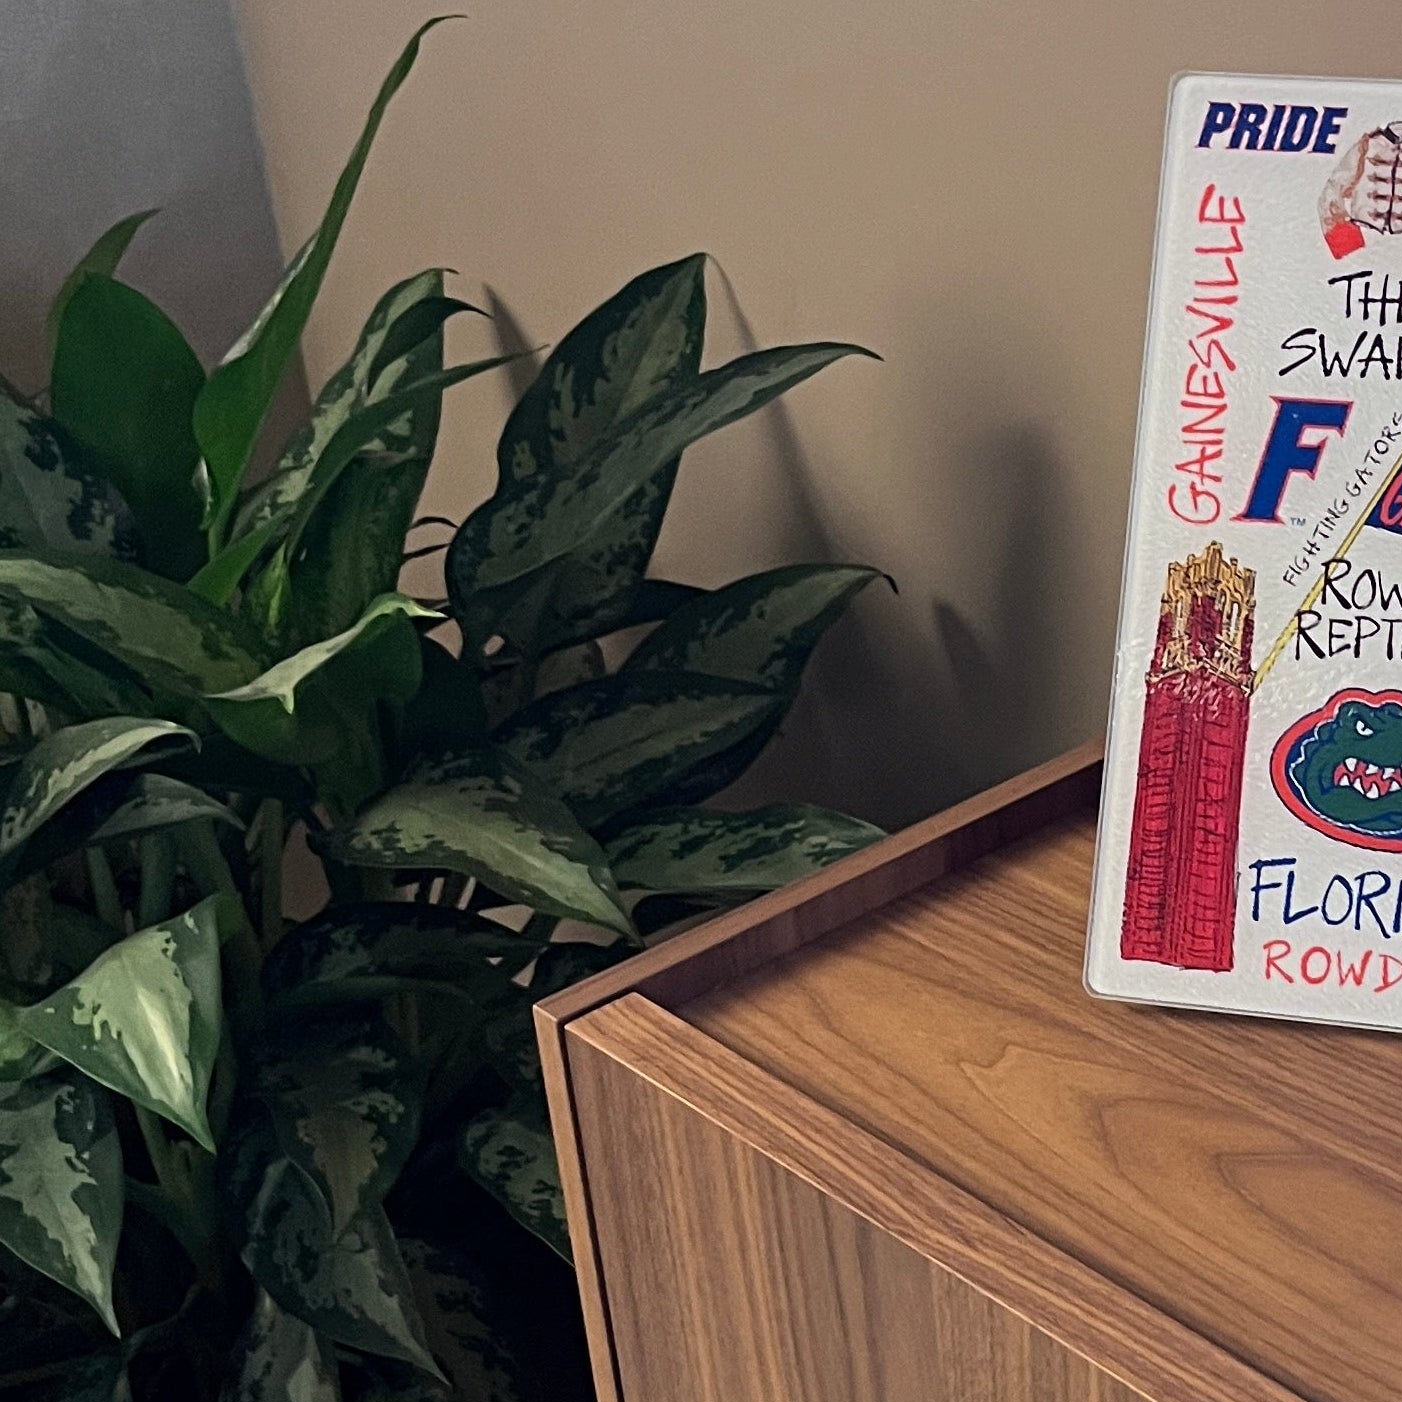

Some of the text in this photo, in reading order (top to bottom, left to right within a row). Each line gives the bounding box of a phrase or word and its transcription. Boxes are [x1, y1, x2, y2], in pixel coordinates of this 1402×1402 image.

[1196, 100, 1349, 154] PRIDE
[1168, 184, 1248, 526] GAINESVILLE
[1231, 394, 1355, 528] F
[1283, 497, 1351, 587] FIGHTING
